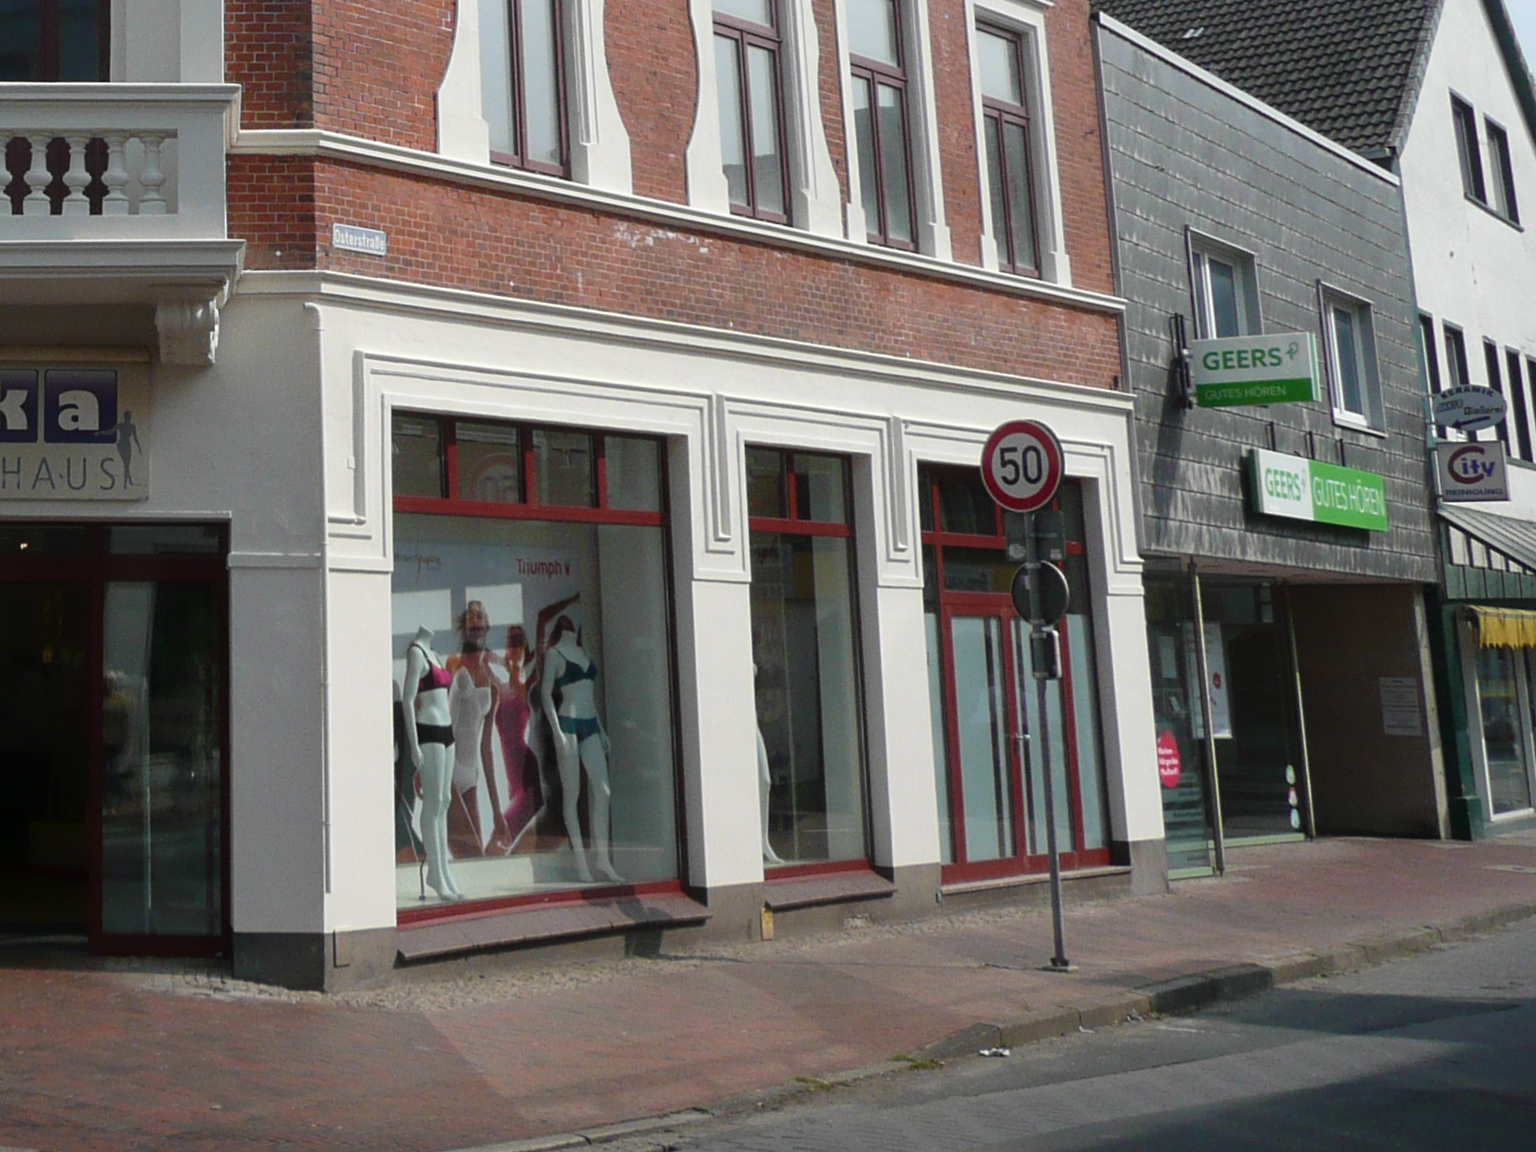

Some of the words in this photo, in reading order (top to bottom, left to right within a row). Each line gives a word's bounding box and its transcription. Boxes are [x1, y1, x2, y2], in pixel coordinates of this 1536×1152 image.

[335, 229, 384, 250] Osterstraße
[1202, 347, 1283, 371] GEERS
[1205, 388, 1242, 400] GUTES
[1244, 385, 1287, 398] HÖREN
[1440, 385, 1495, 399] KERAMIK
[999, 445, 1043, 486] 50
[1447, 445, 1496, 485] City
[1265, 467, 1302, 501] GEERS
[1312, 476, 1348, 511] GUTES
[1349, 479, 1385, 516] HÖREN
[516, 557, 563, 579] Triumph
